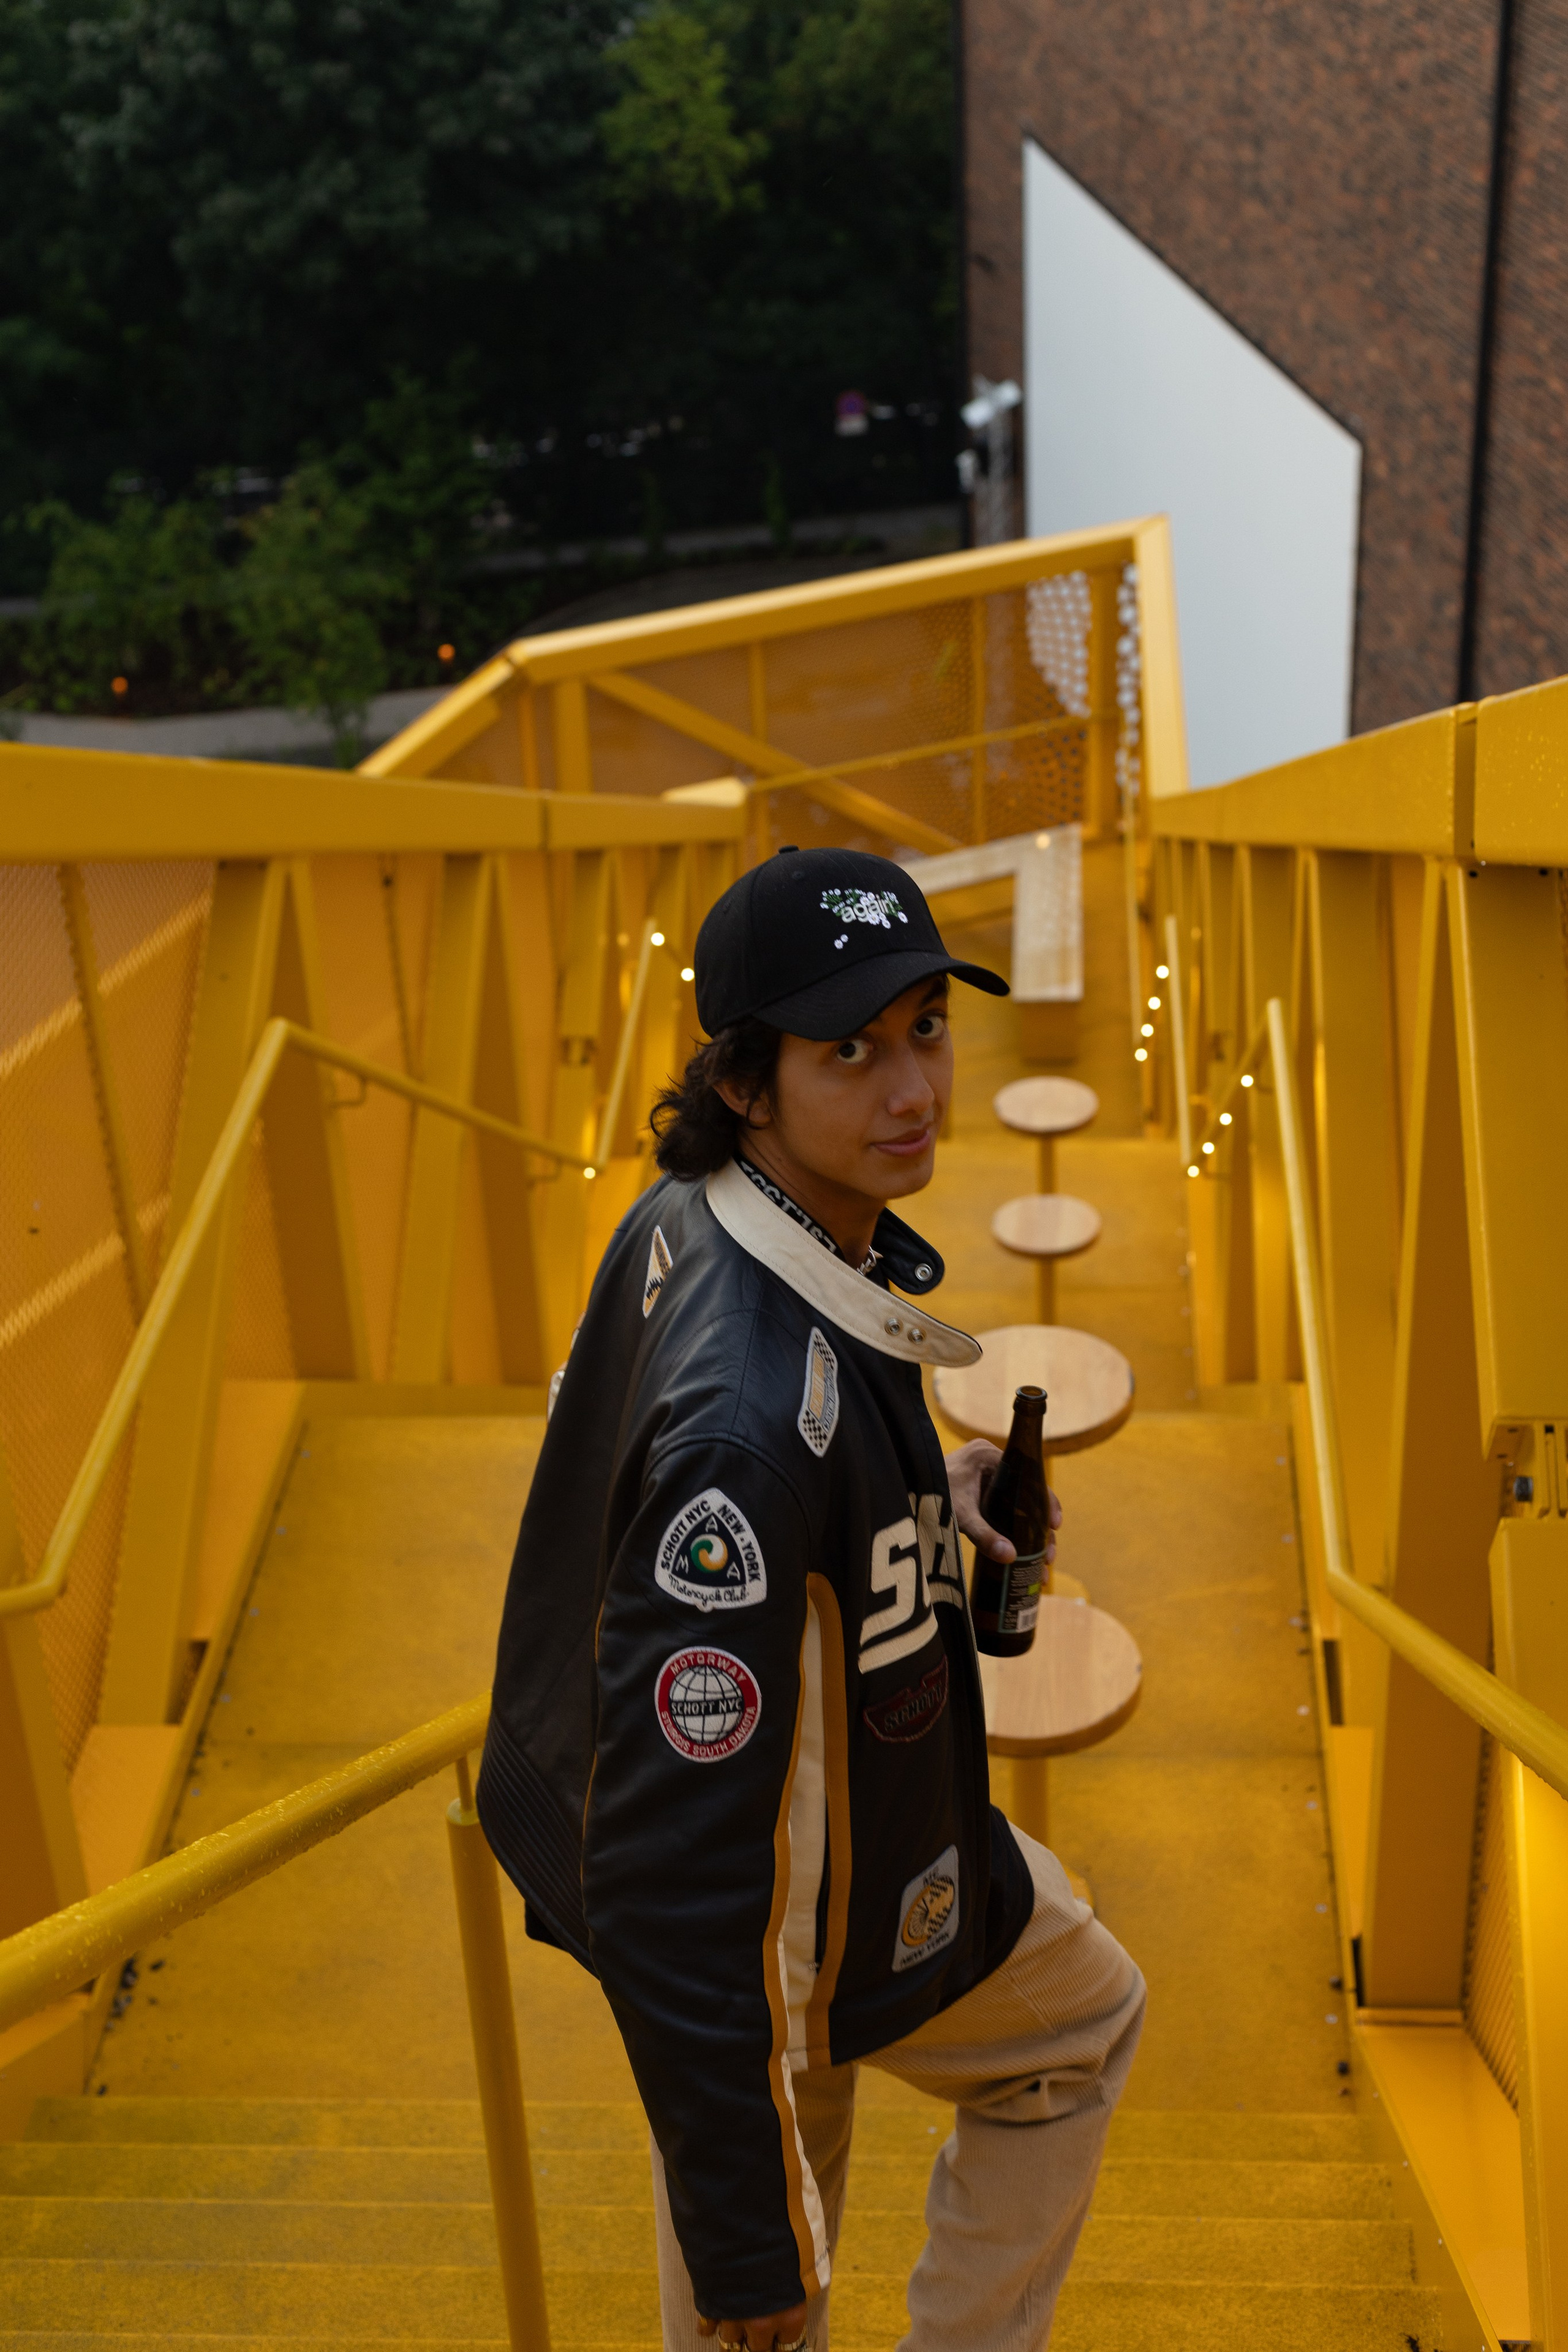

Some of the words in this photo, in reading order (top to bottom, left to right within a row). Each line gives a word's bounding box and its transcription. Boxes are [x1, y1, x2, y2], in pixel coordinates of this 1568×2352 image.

[661, 1520, 688, 1572] SCHOTT
[685, 1501, 711, 1525] NYC
[717, 1504, 745, 1536] NEW
[742, 1540, 761, 1583] YORK
[670, 1654, 747, 1683] MOTORWAY
[671, 1702, 715, 1715] SCHOTT
[718, 1698, 742, 1713] NYC
[693, 1742, 729, 1757] SOUTH
[729, 1706, 756, 1746] DAKOTA
